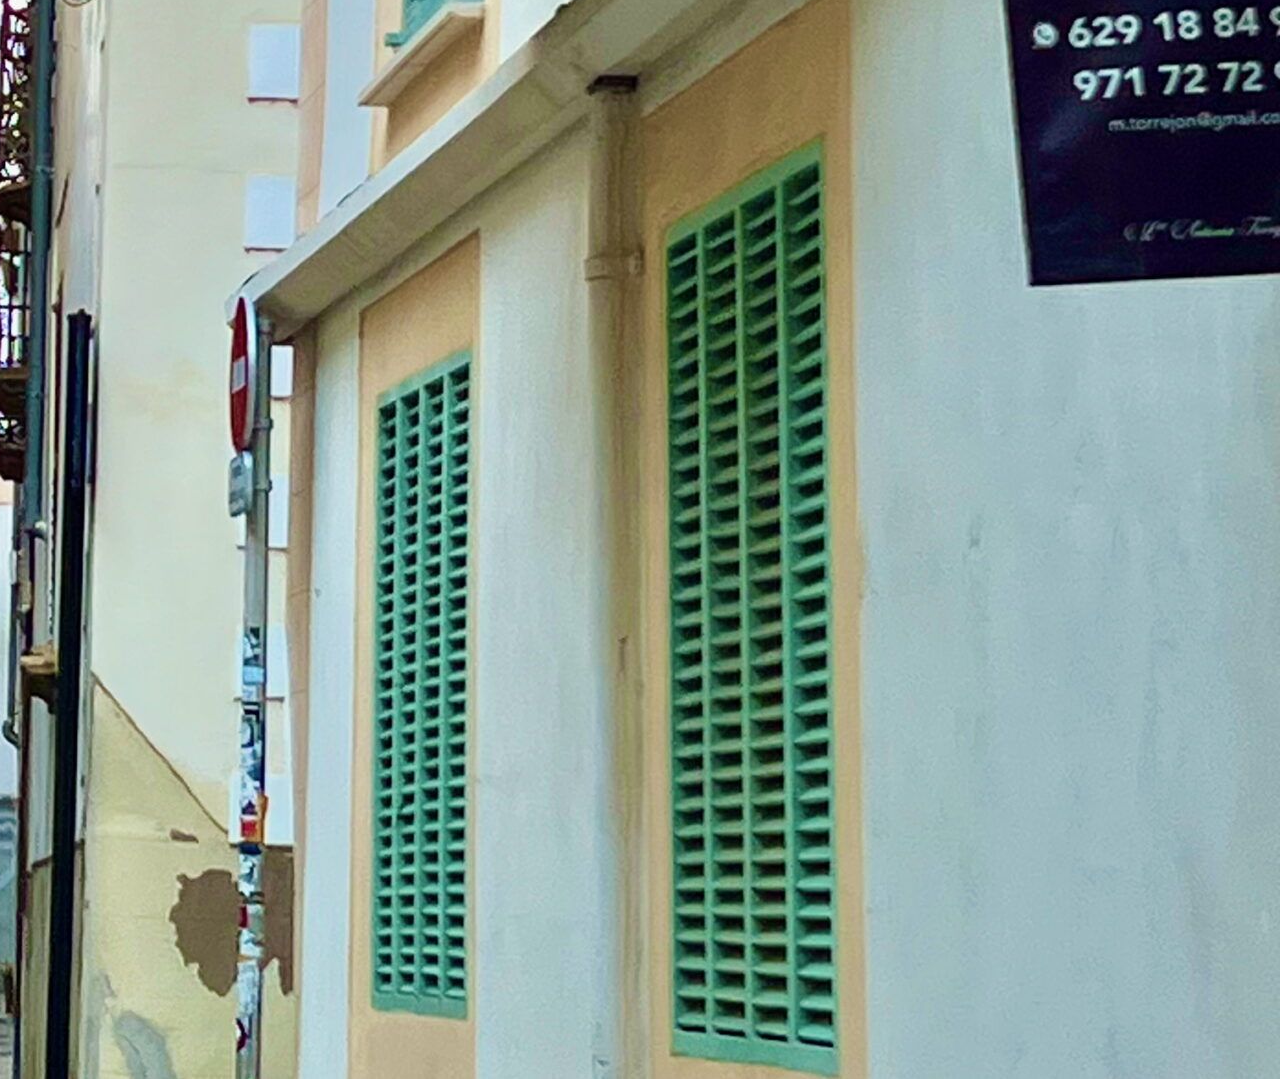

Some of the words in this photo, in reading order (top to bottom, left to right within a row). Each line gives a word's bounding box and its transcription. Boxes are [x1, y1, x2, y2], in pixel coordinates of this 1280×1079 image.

[1068, 14, 1143, 49] 629
[1153, 9, 1203, 42] 18
[1213, 7, 1262, 39] 84
[1073, 67, 1147, 102] 971
[1158, 63, 1209, 96] 72
[1217, 61, 1267, 94] 72
